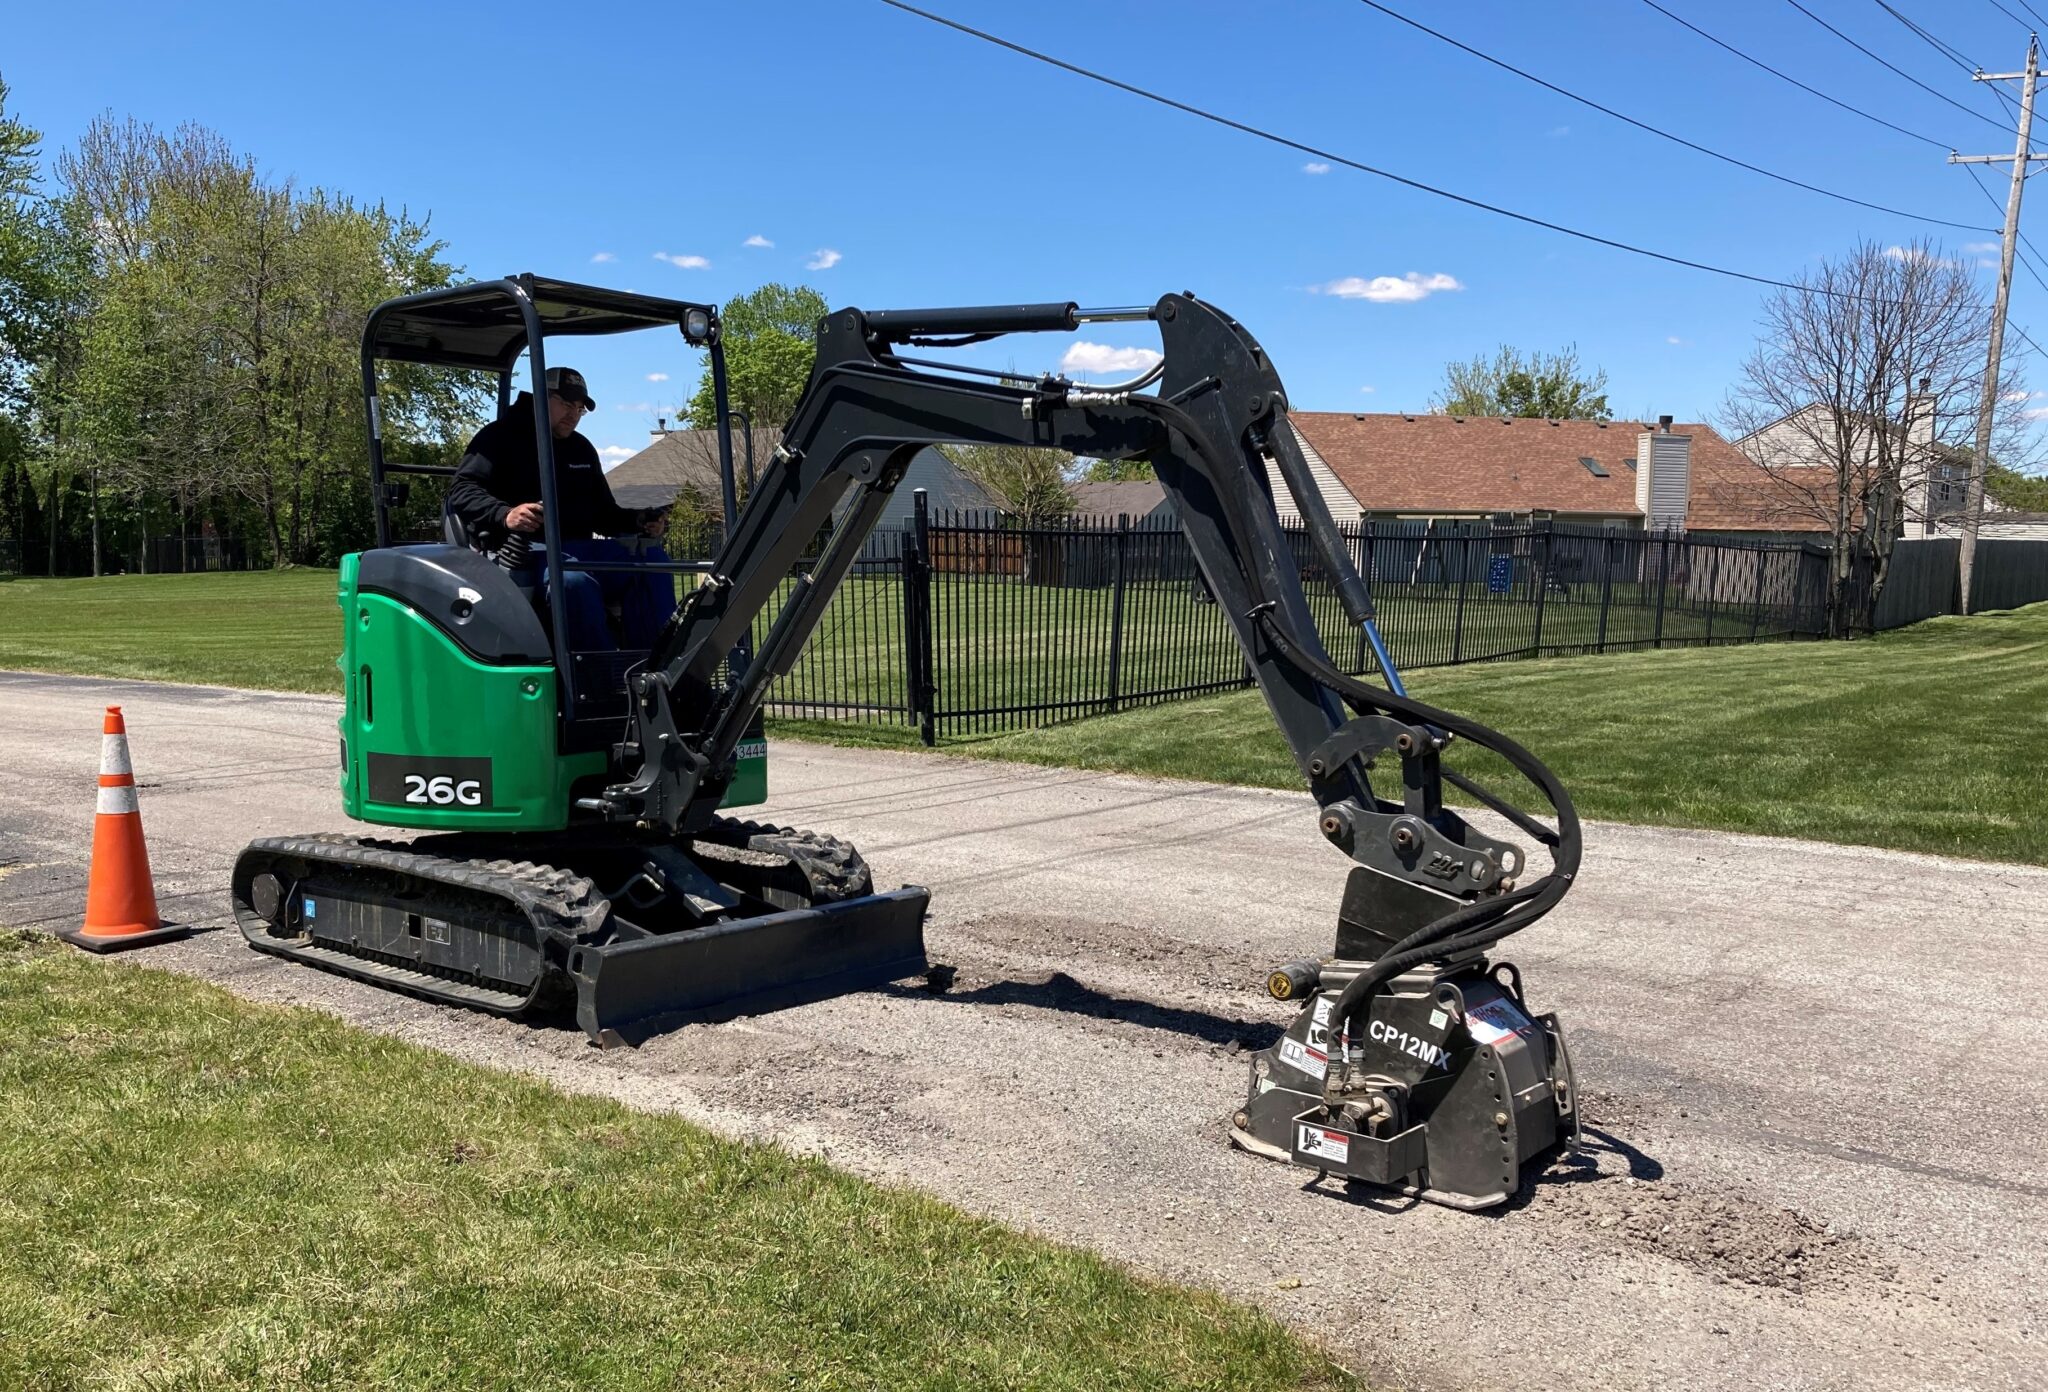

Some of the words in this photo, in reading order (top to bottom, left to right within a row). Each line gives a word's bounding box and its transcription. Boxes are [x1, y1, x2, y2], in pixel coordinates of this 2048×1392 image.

[735, 744, 766, 759] 3444
[405, 775, 481, 805] 26G
[1370, 1020, 1452, 1071] CP12MX
